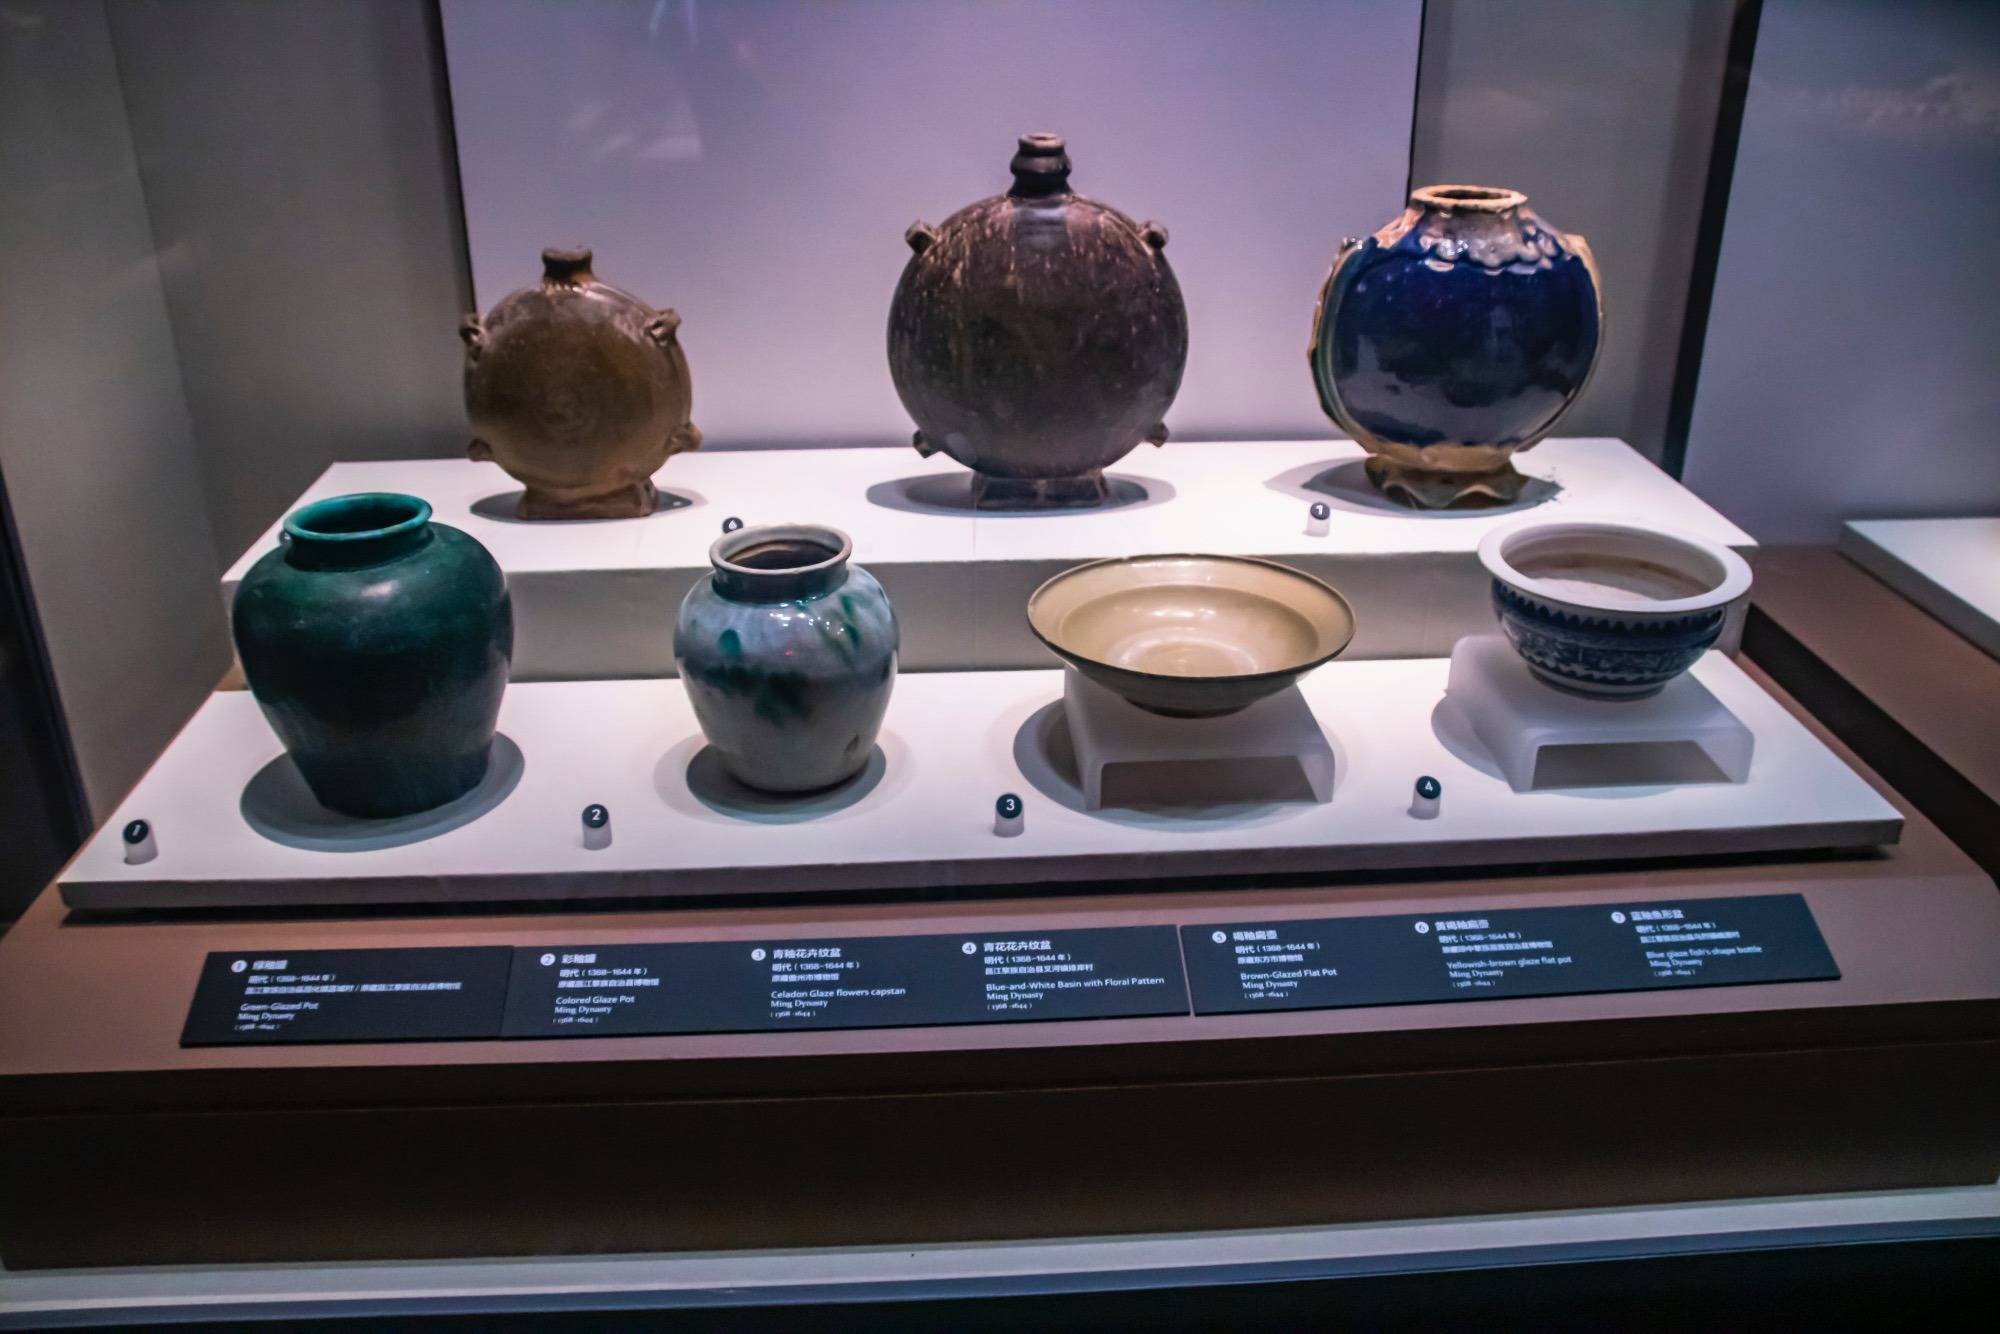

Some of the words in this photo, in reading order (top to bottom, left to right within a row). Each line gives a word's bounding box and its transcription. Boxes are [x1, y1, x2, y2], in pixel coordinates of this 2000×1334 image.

[1424, 780, 1434, 792] 4
[1006, 798, 1015, 811] 3
[591, 808, 601, 821] 2
[1446, 959, 1517, 969] Yellowish-brown
[1518, 957, 1541, 968] glaze
[1541, 956, 1557, 965] flat
[1558, 956, 1572, 965] pot
[1240, 970, 1302, 981] Brown-Glazed
[1304, 968, 1321, 977] Flat
[1322, 968, 1338, 976] Pot
[1448, 970, 1472, 979] Ming
[1472, 969, 1504, 978] Dynasty
[986, 981, 1055, 992] Blue-and-White
[1057, 981, 1082, 989] Basin
[1083, 978, 1103, 988] with
[1104, 978, 1130, 987] Floral
[1131, 977, 1165, 985] Pattern
[1242, 982, 1265, 990] Ming
[1266, 980, 1298, 989] Dynasty
[770, 990, 808, 999] Celadon
[809, 989, 835, 998] Glaze
[836, 988, 869, 997] flowers
[870, 988, 906, 998] capstan
[986, 994, 1009, 1002] Ming
[1010, 992, 1044, 1001] Dynasty
[555, 996, 591, 1005] Colored
[592, 996, 618, 1004] Glaze
[620, 995, 635, 1003] Pot
[770, 1000, 793, 1009] Ming
[794, 1000, 829, 1009] Dynasty
[303, 1002, 319, 1010] Pot
[554, 1006, 577, 1015] Ming
[578, 1005, 612, 1014] Dynasty
